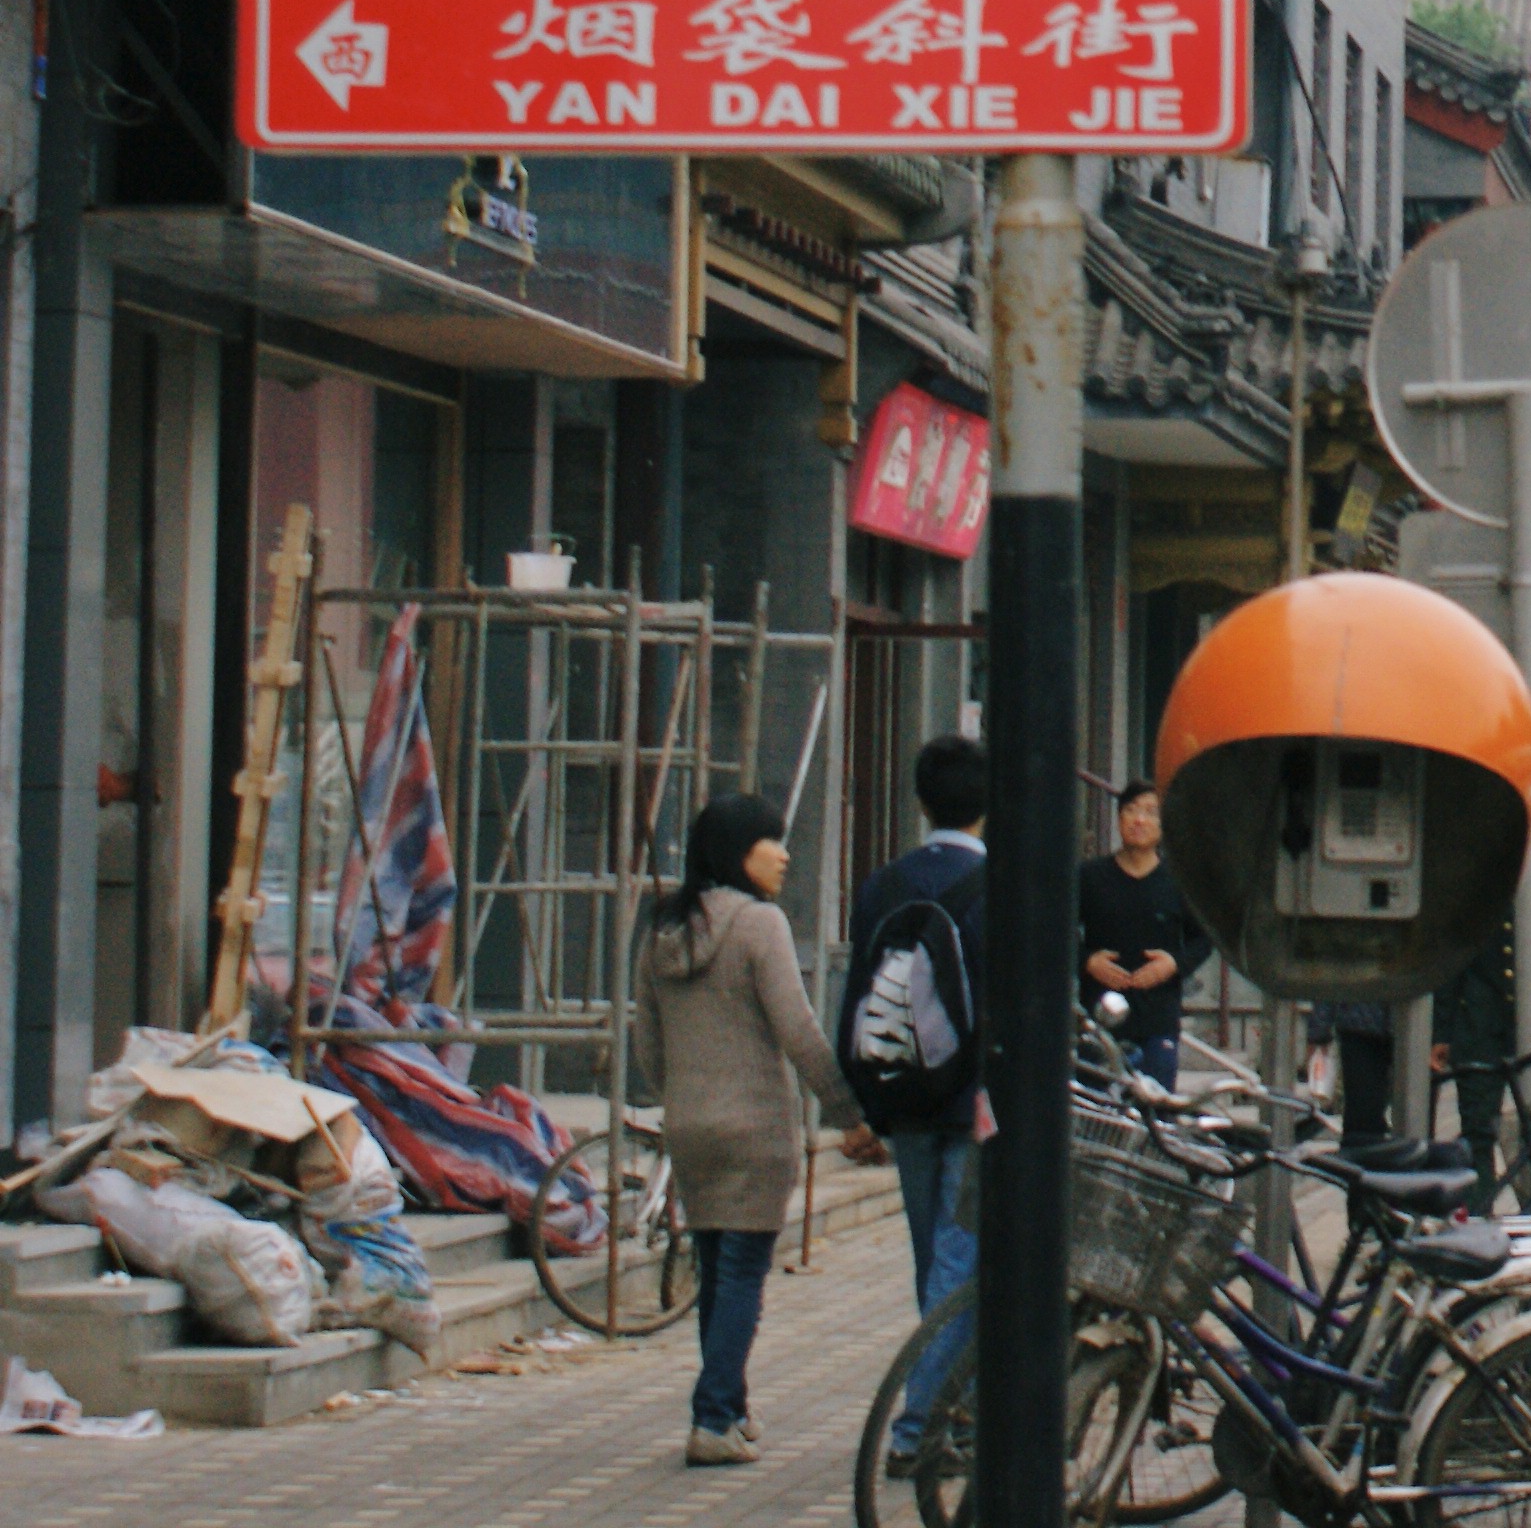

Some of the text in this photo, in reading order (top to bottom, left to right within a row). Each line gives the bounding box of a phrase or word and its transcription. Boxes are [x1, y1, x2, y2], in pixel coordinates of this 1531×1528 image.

[320, 32, 373, 80] 西
[491, 80, 1184, 131] YAN DAI XIE JIE
